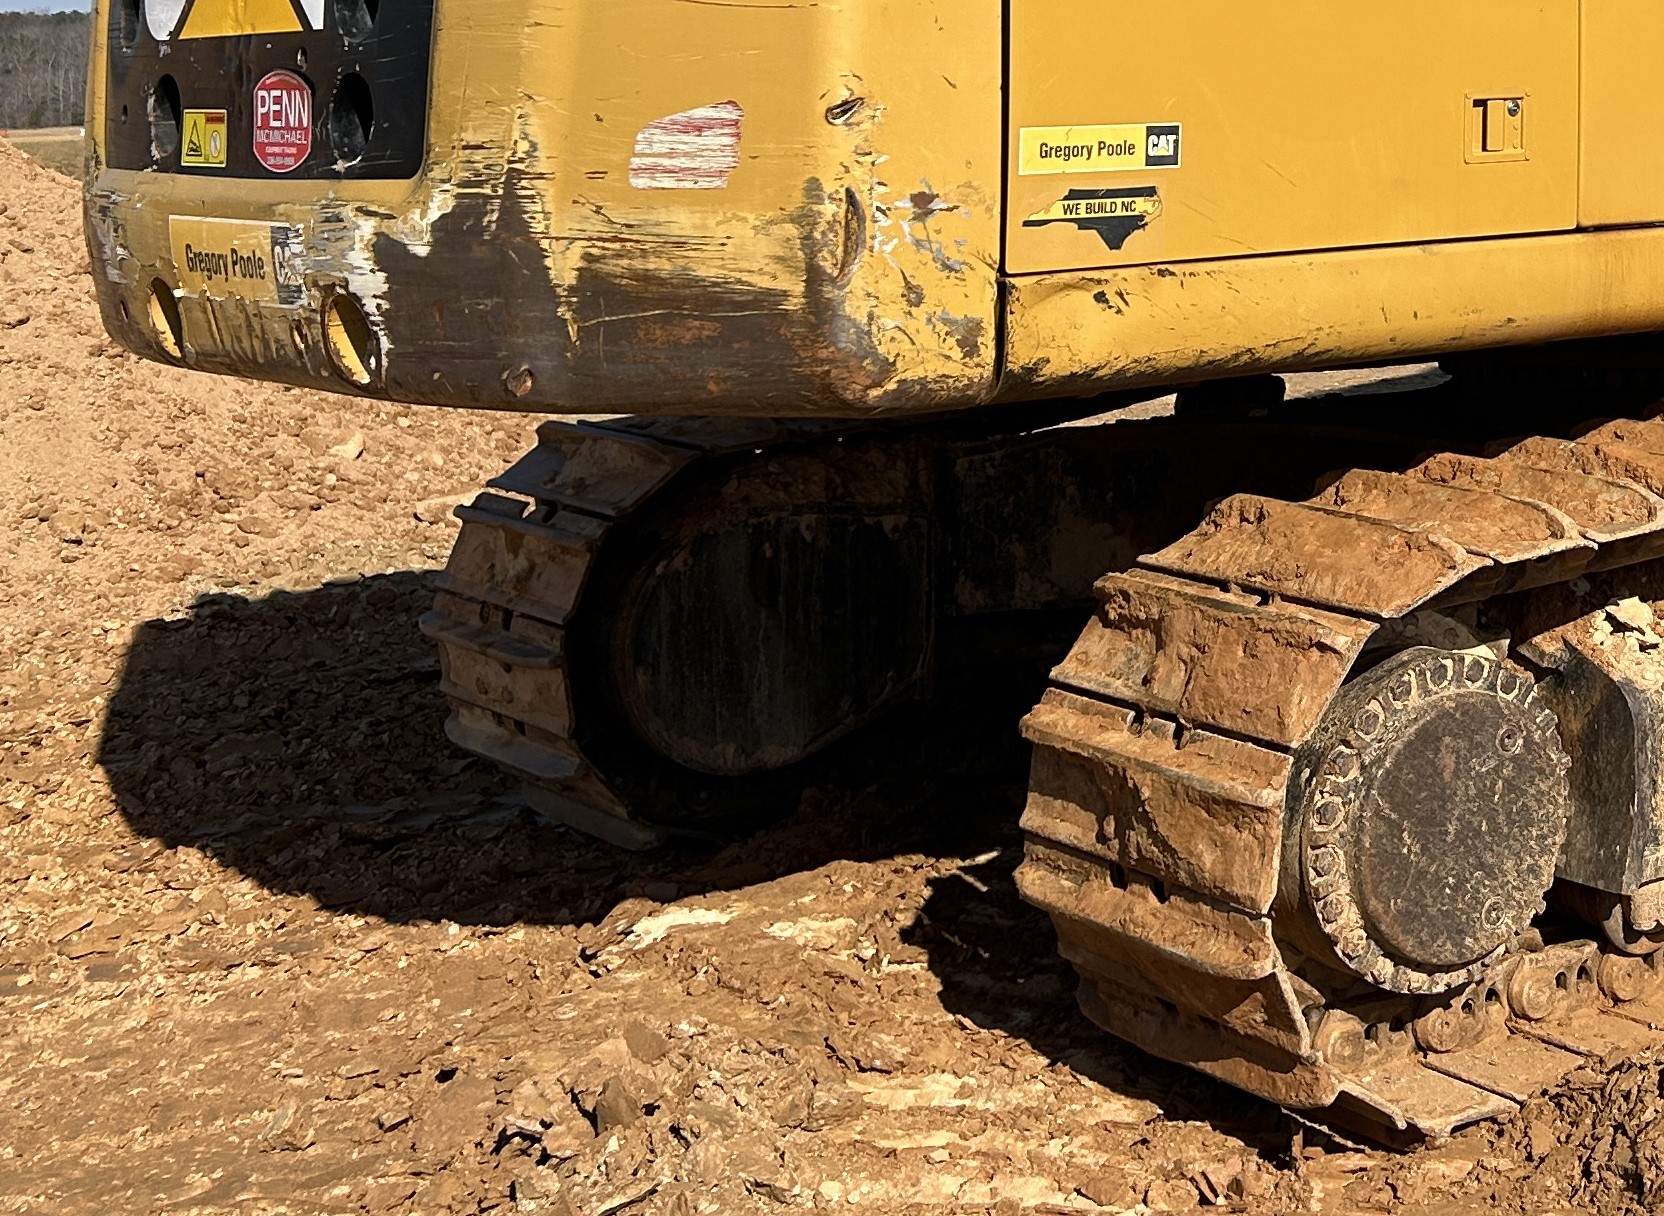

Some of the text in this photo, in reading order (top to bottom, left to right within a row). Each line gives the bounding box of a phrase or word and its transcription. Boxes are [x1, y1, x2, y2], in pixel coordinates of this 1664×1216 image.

[256, 89, 309, 128] PENN
[1039, 134, 1178, 162] Gregory Poole CAT
[1062, 200, 1137, 216] WE BUILD NC
[185, 242, 229, 283] Gregory
[230, 247, 266, 281] Poole
